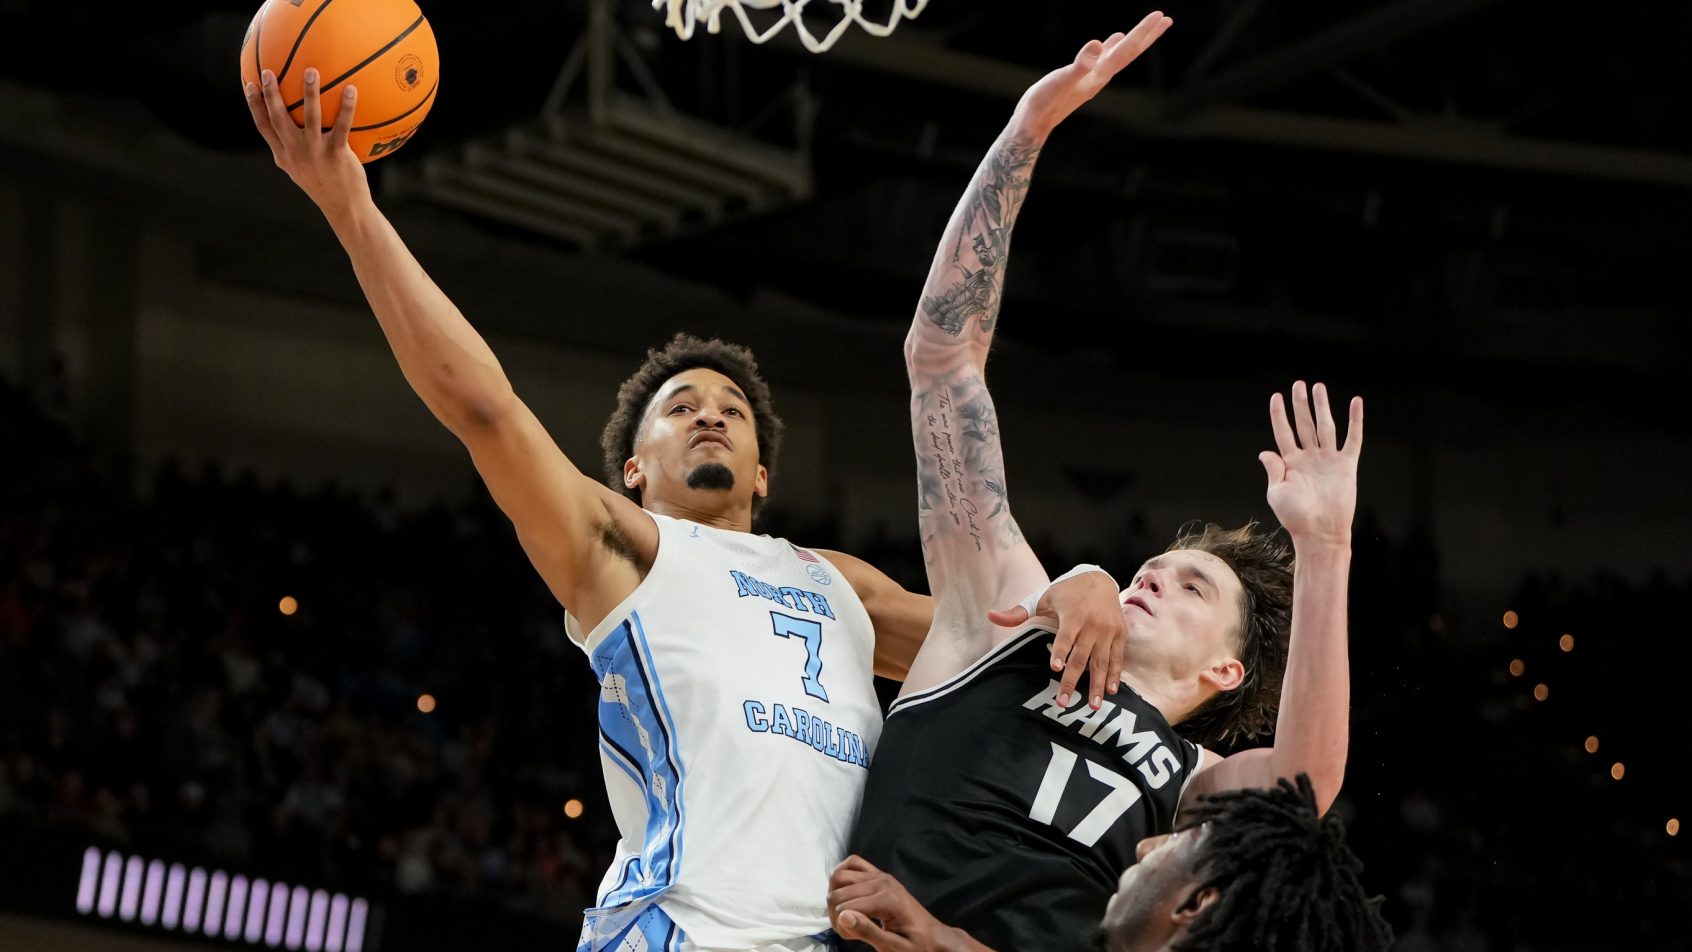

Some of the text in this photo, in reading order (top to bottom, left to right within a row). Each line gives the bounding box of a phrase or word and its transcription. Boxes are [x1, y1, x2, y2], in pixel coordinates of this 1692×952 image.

[927, 413, 937, 427] the
[936, 388, 952, 413] The
[951, 458, 964, 477] that
[729, 570, 836, 621] NORTH
[769, 611, 830, 704] 7
[1021, 678, 1182, 790] RAMS
[1028, 741, 1143, 848] 17
